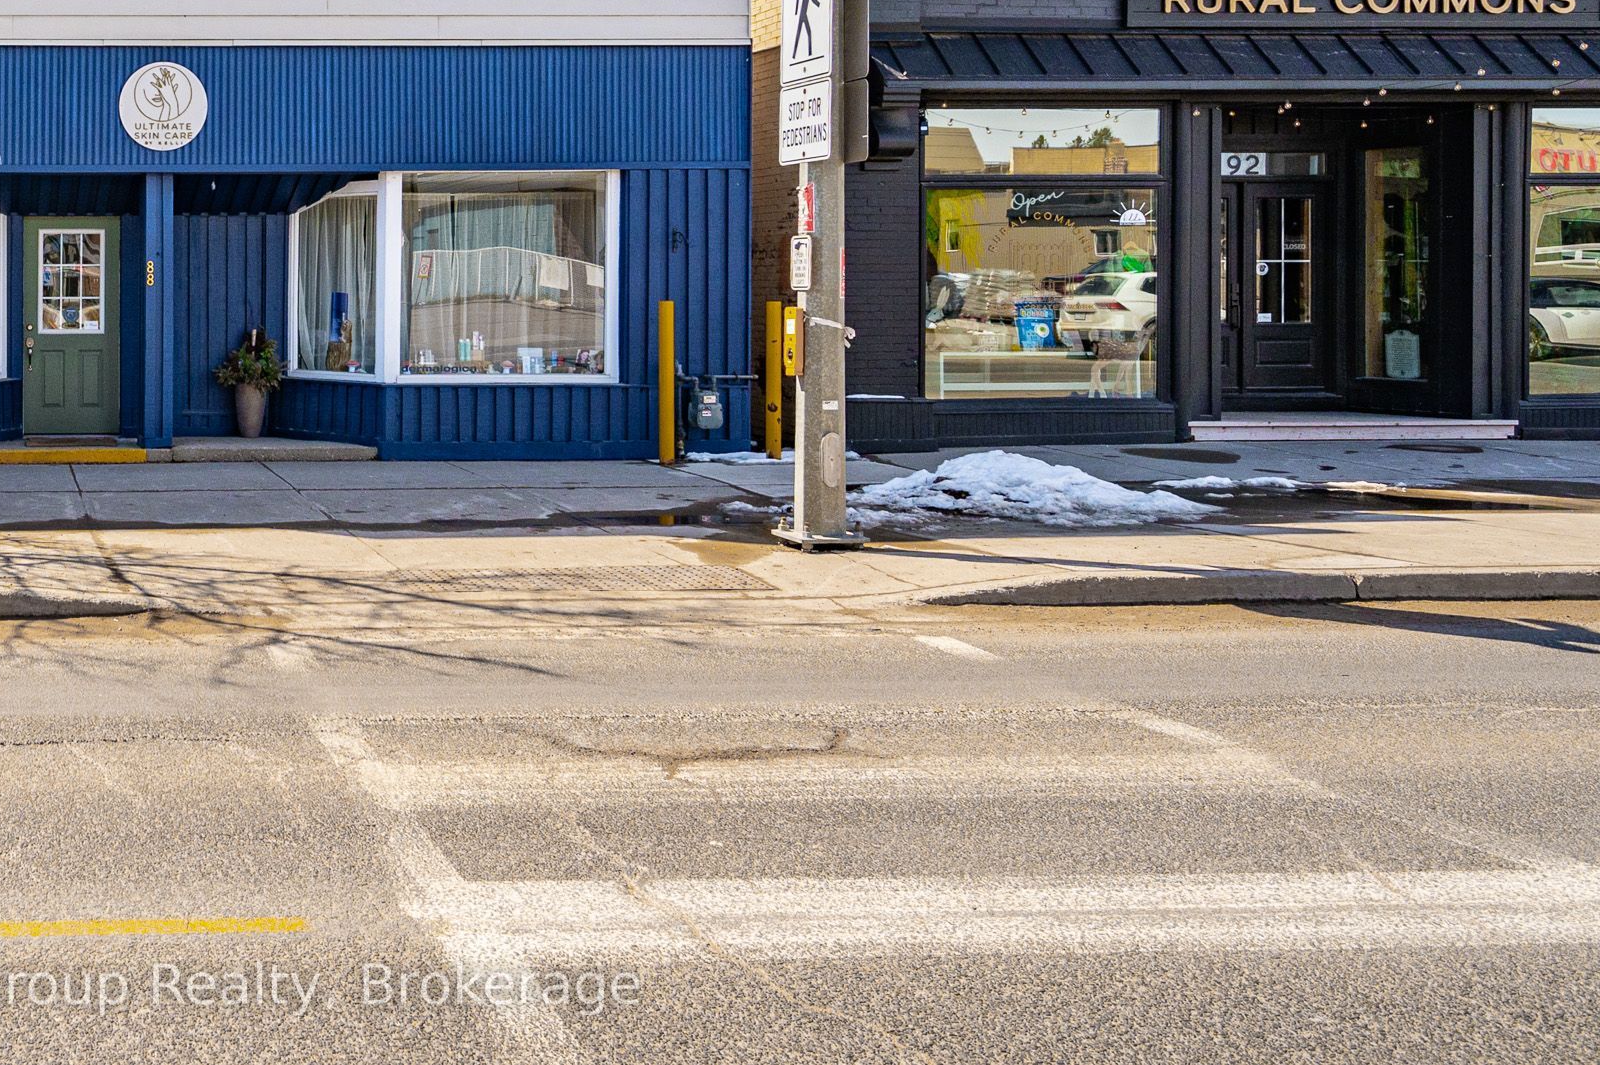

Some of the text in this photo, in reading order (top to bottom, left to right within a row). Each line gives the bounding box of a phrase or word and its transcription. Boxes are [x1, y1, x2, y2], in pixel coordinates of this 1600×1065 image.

[788, 97, 822, 121] STOP FOR
[134, 123, 192, 131] ULTIMATE
[134, 132, 193, 140] SKIN CARE
[782, 122, 827, 148] PEDESTRIANS
[1227, 154, 1260, 176] 92
[1010, 191, 1065, 217] Open
[988, 217, 1027, 253] RURAL
[401, 364, 478, 373] dermalogica
